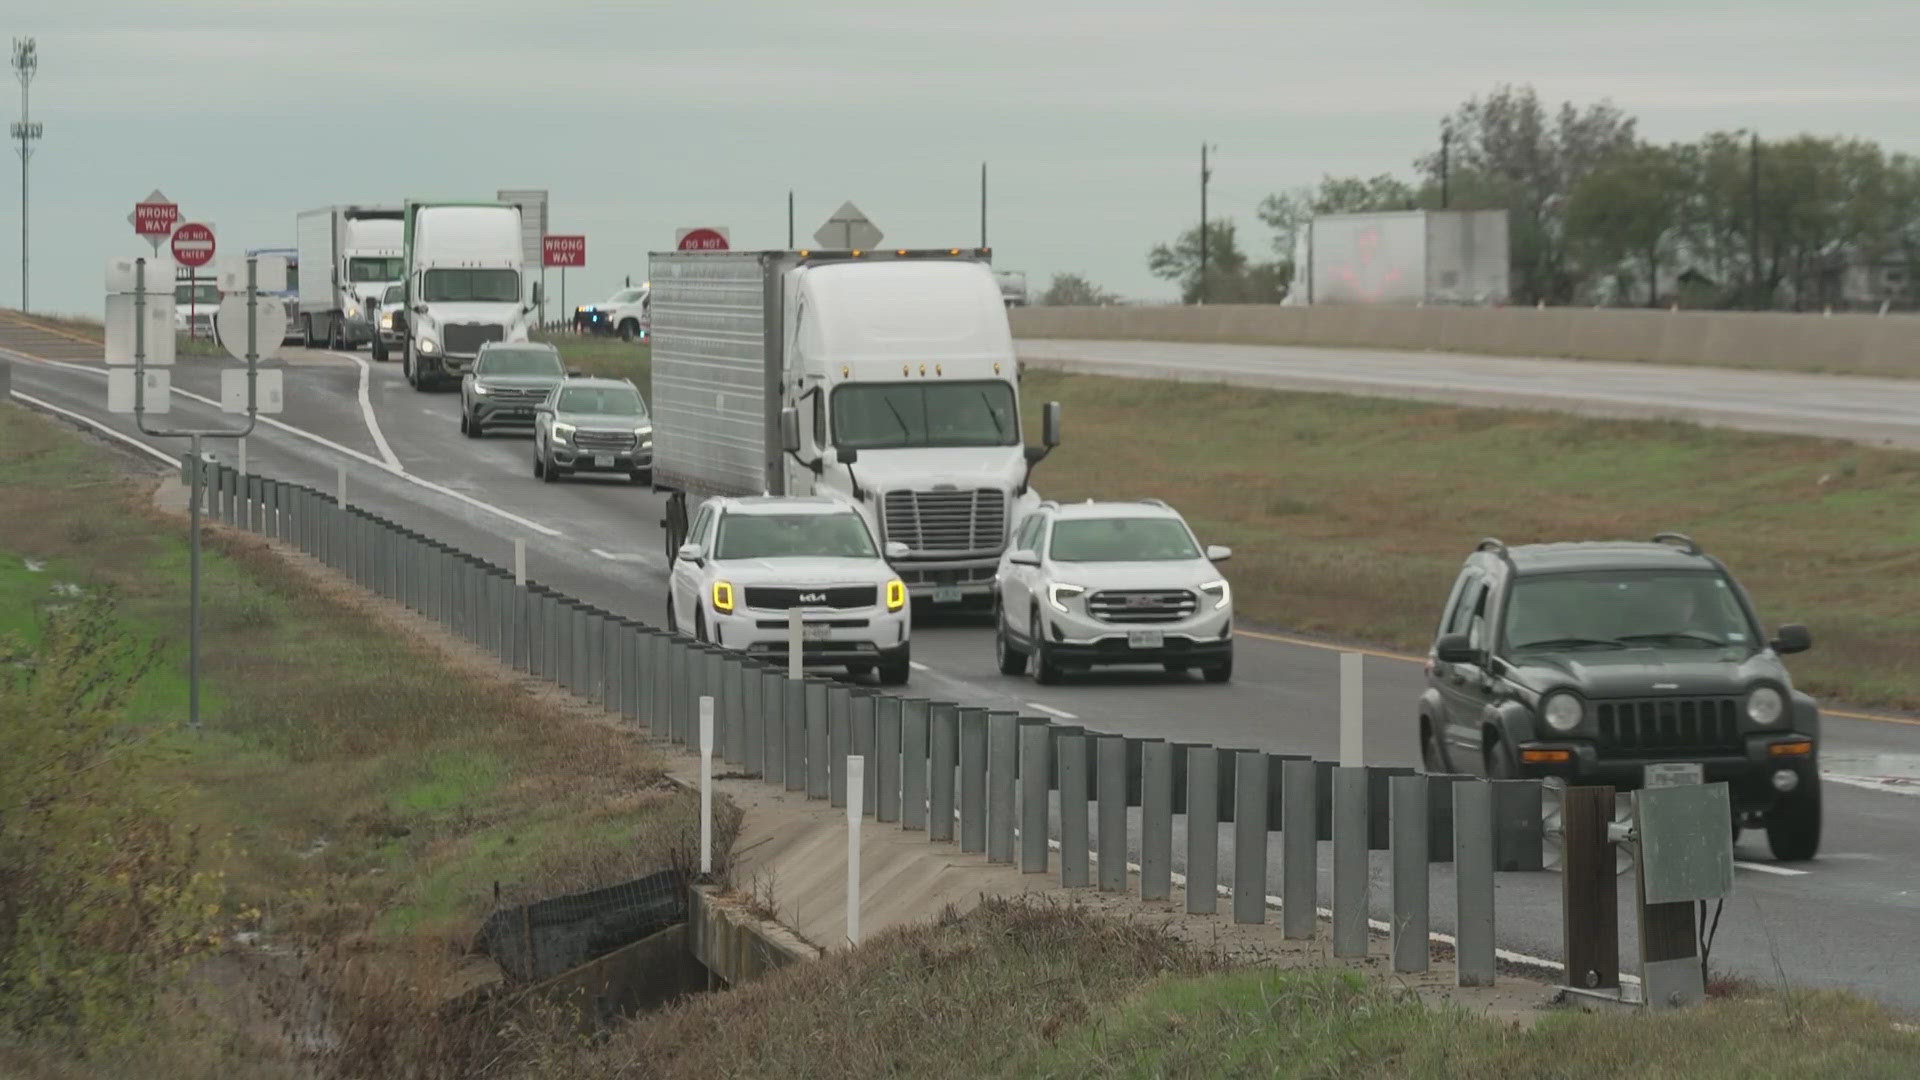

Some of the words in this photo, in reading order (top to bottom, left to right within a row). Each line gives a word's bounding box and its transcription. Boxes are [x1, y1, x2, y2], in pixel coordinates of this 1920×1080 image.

[138, 206, 176, 219] WRONG
[145, 220, 168, 231] WAY
[179, 231, 189, 240] DO
[193, 231, 208, 240] NOT
[545, 239, 583, 251] WRONG
[685, 239, 698, 249] DO
[703, 239, 721, 249] NOT
[181, 250, 205, 259] ENTER
[553, 252, 576, 263] WAY
